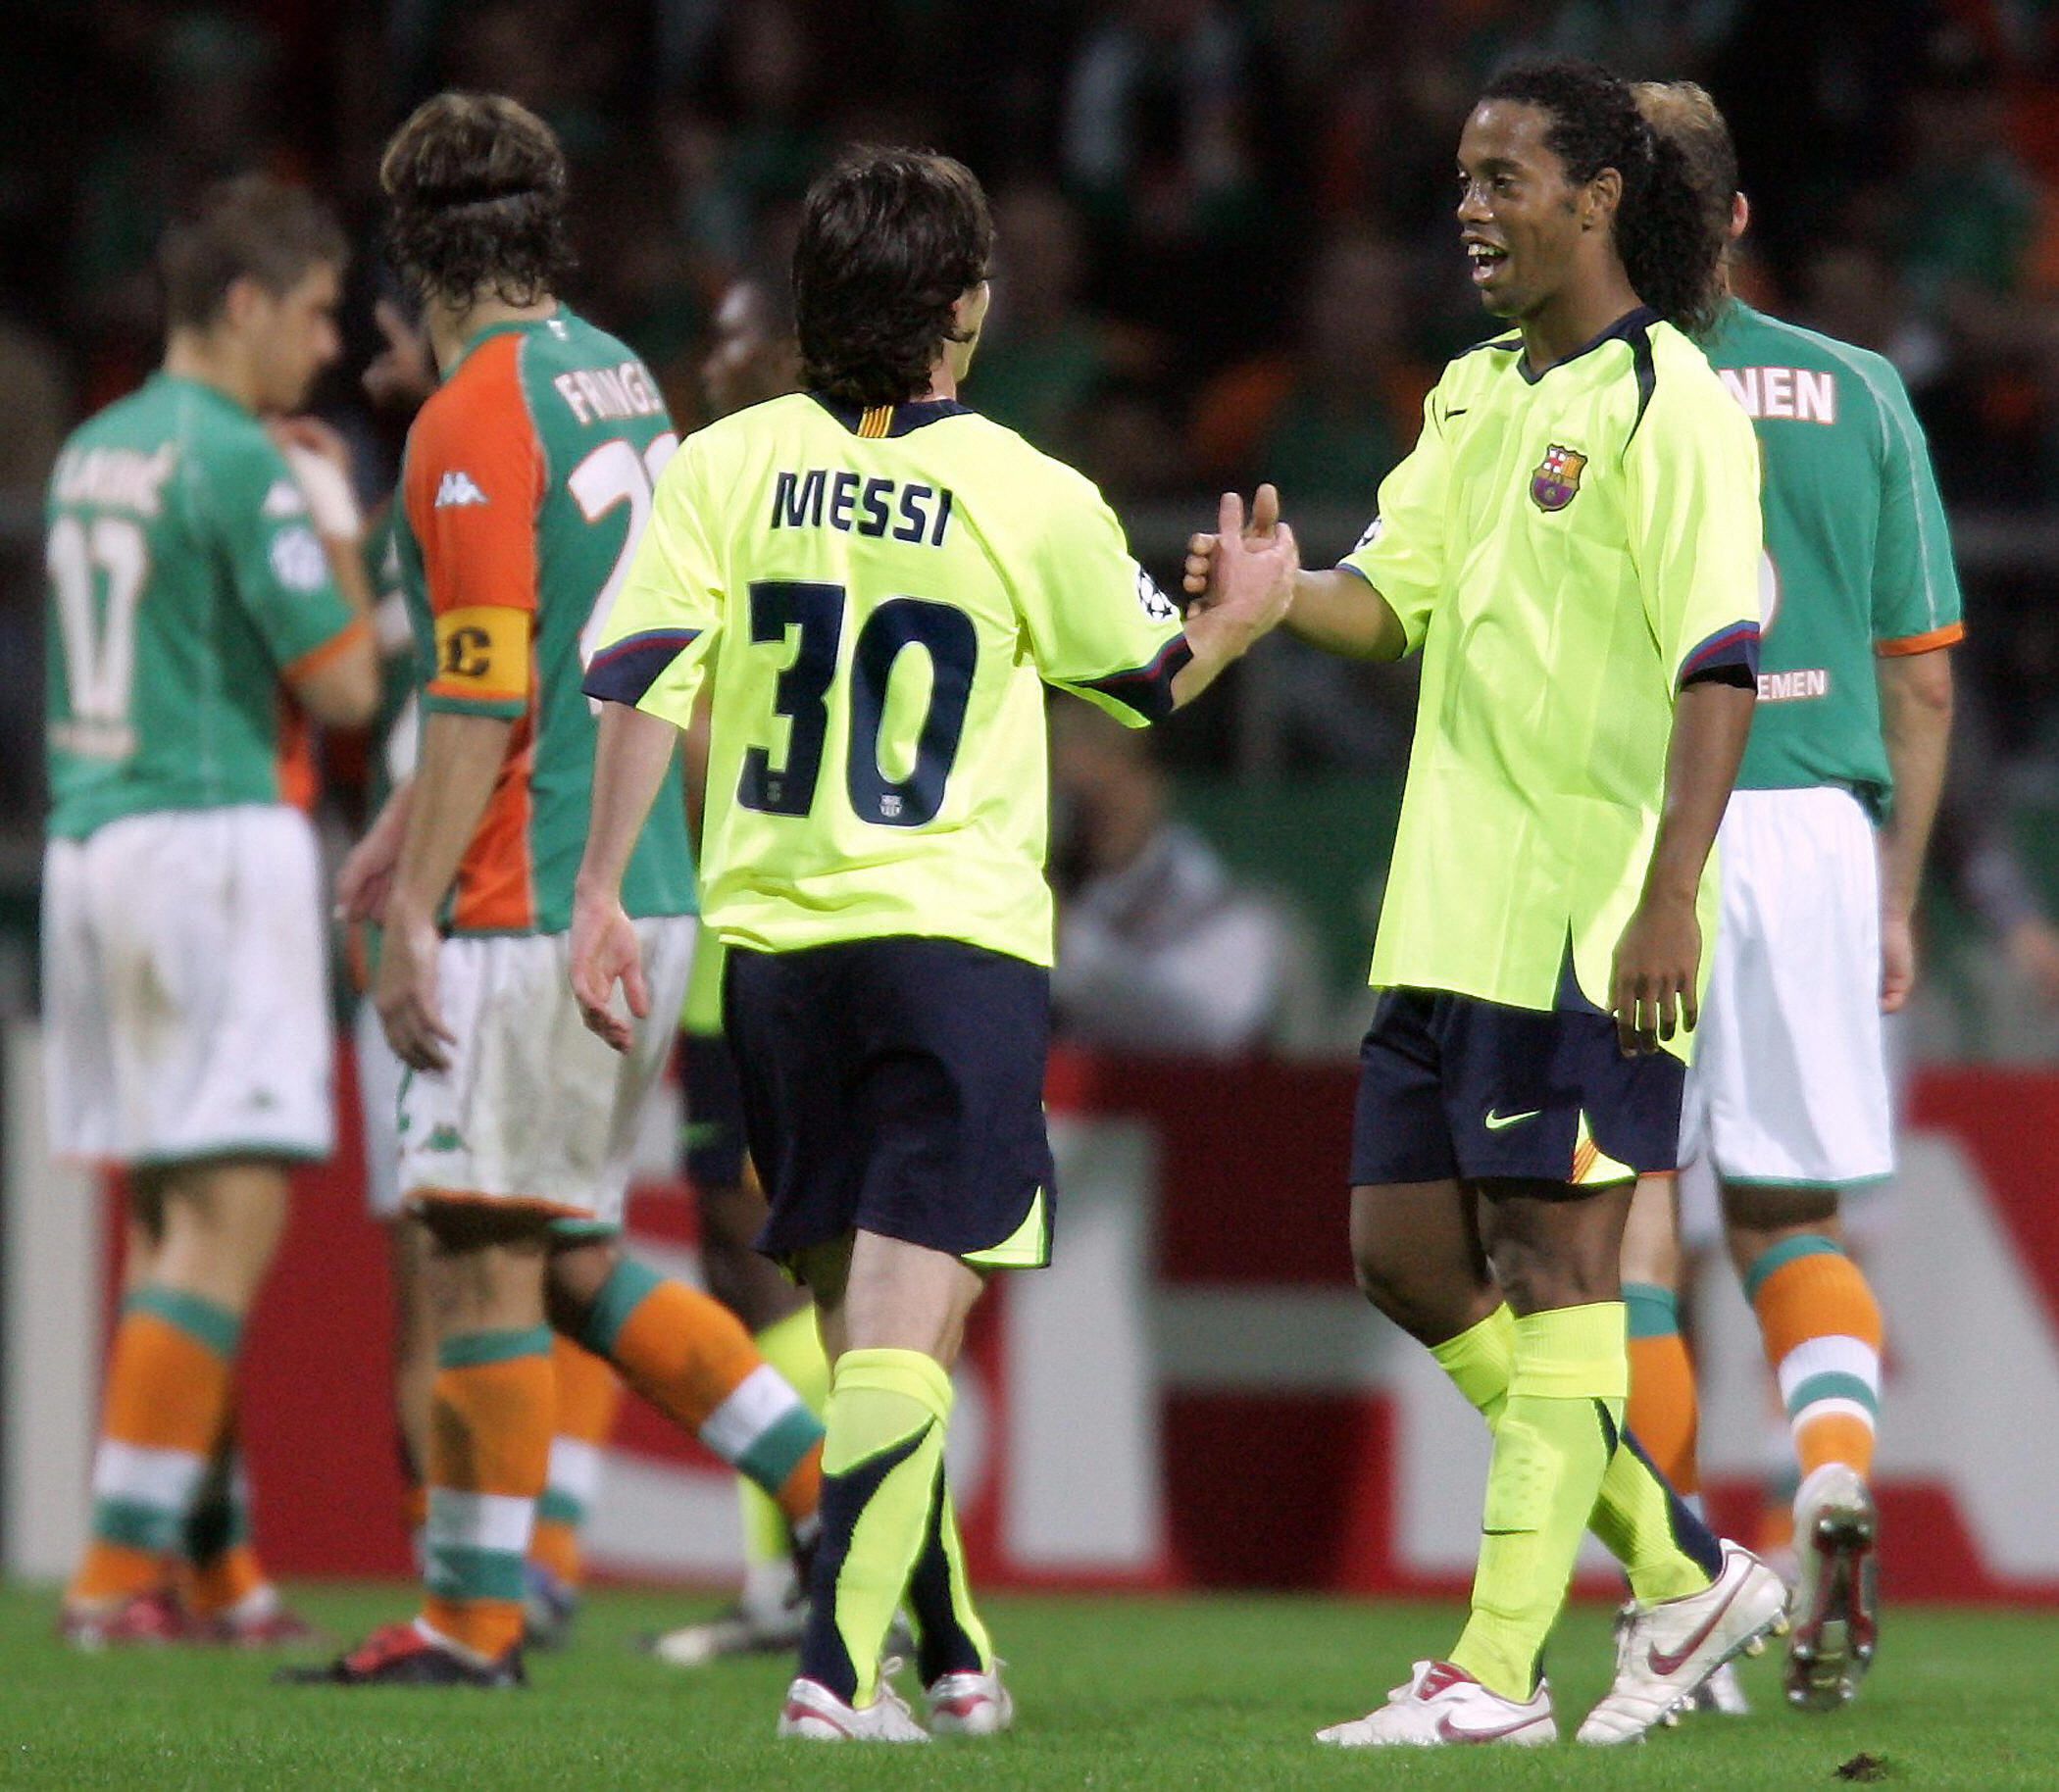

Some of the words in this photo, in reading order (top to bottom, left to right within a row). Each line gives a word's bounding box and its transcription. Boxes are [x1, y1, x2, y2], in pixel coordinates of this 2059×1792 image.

[1719, 367, 1836, 424] NEN
[771, 470, 953, 547] MESSI
[736, 580, 979, 827] 30
[1756, 669, 1826, 700] EMEN
